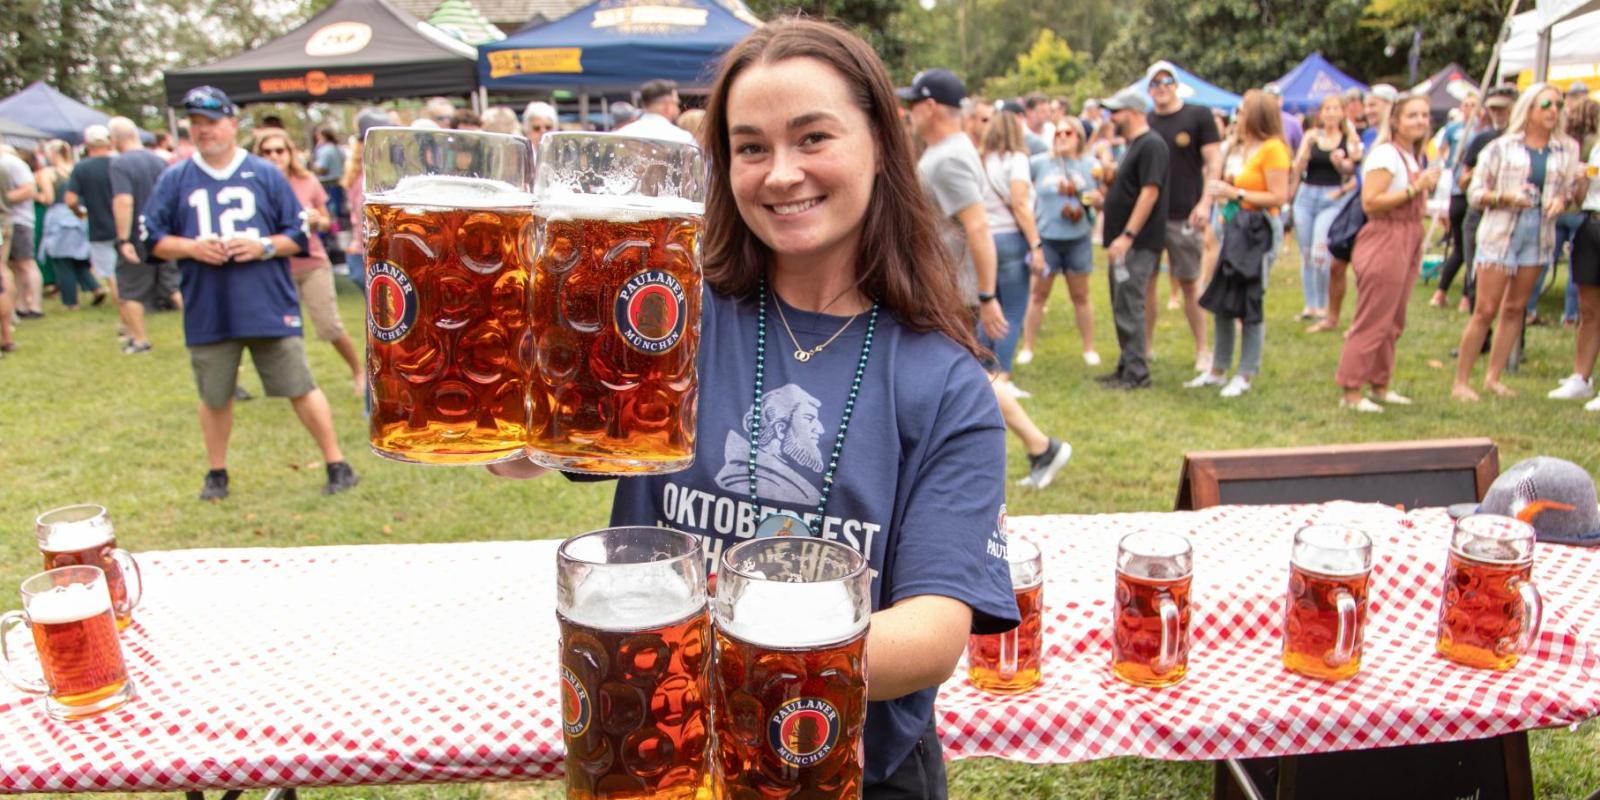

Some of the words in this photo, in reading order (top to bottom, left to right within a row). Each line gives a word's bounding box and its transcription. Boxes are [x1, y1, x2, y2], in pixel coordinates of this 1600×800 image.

[188, 186, 260, 240] 12
[367, 263, 412, 295] ULANER
[620, 272, 684, 303] PAULANER
[663, 482, 880, 560] OKTOBEST
[987, 538, 1008, 560] PAUL
[561, 667, 586, 699] LANER
[773, 700, 836, 724] PAULANER
